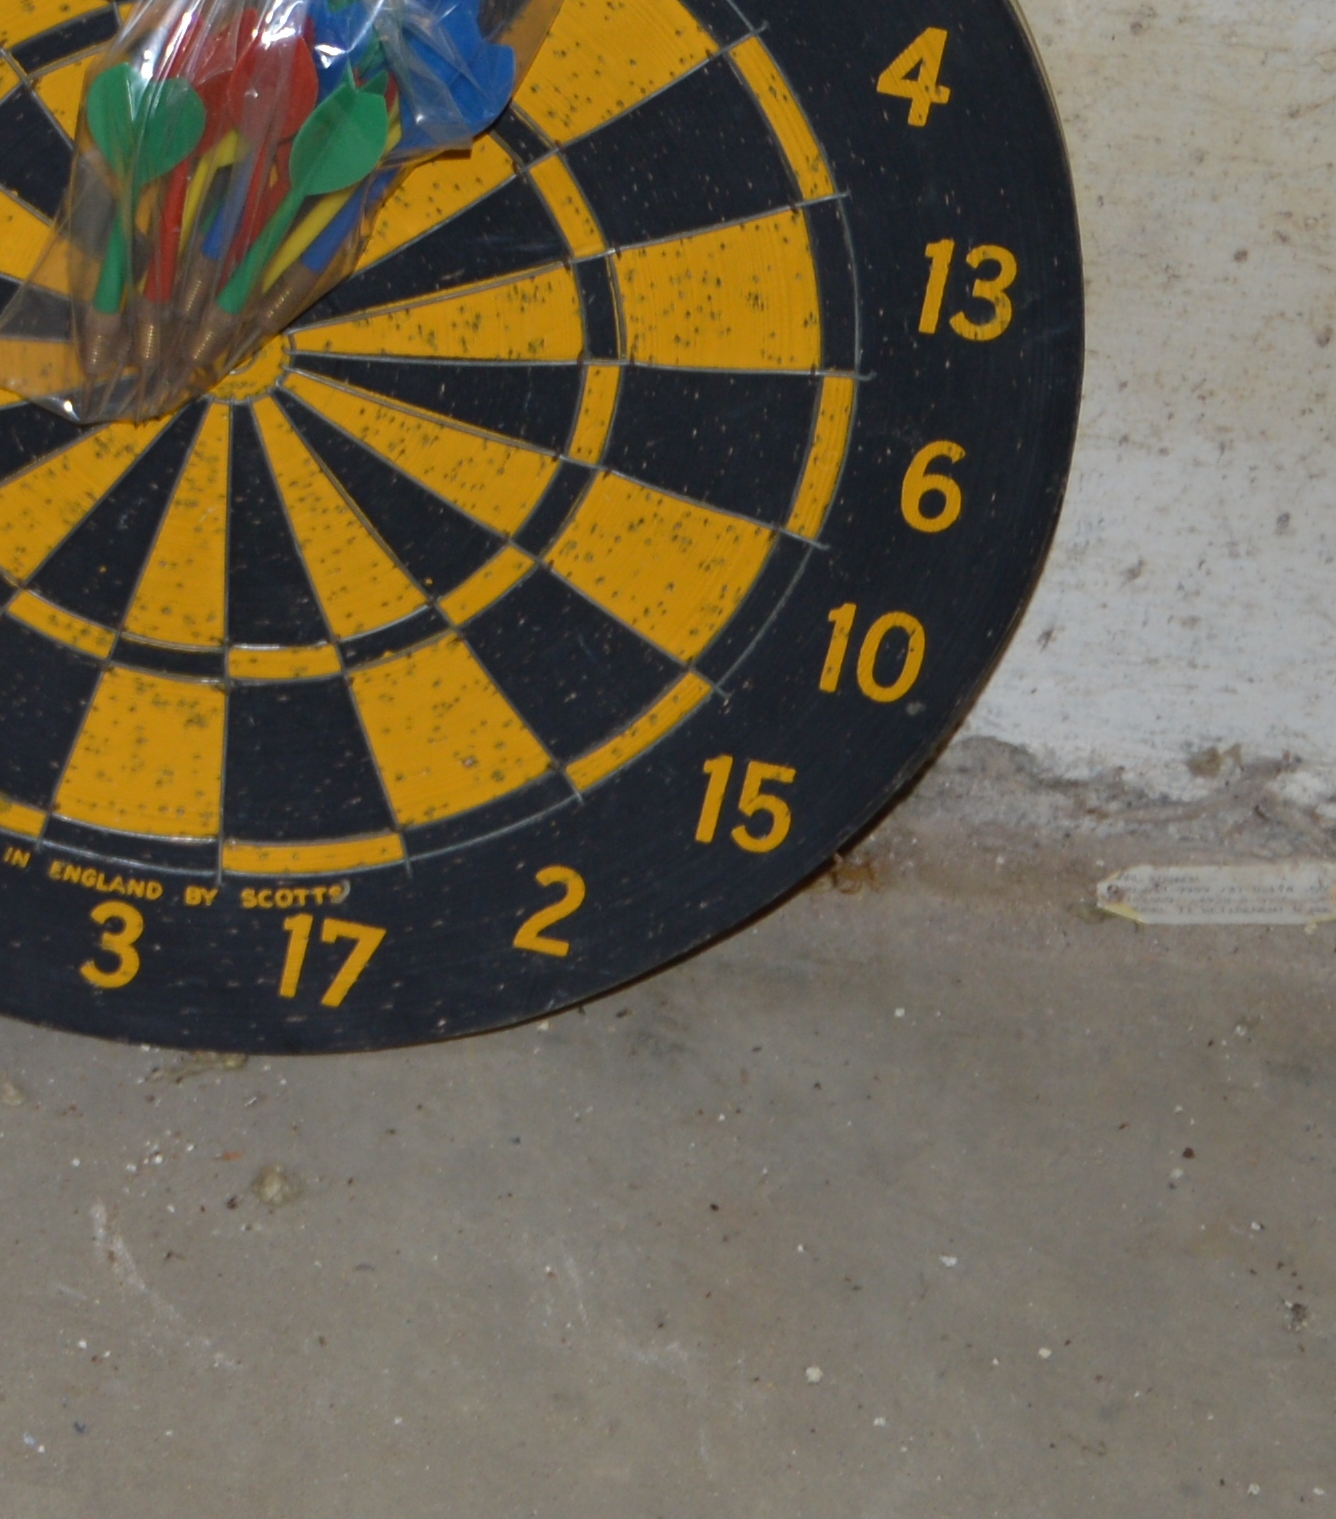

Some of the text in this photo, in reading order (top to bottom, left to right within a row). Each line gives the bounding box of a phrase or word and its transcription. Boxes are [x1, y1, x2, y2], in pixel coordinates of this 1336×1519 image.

[876, 26, 951, 127] 4
[918, 238, 1018, 341] 13
[900, 440, 966, 533] 6
[819, 602, 926, 703] 10
[695, 754, 797, 853] 15
[3, 846, 31, 869] IN
[48, 860, 163, 900] ENGLAND
[184, 884, 219, 907] BY
[512, 865, 586, 958] 2
[79, 900, 144, 989] 3
[279, 913, 387, 1009] 17
